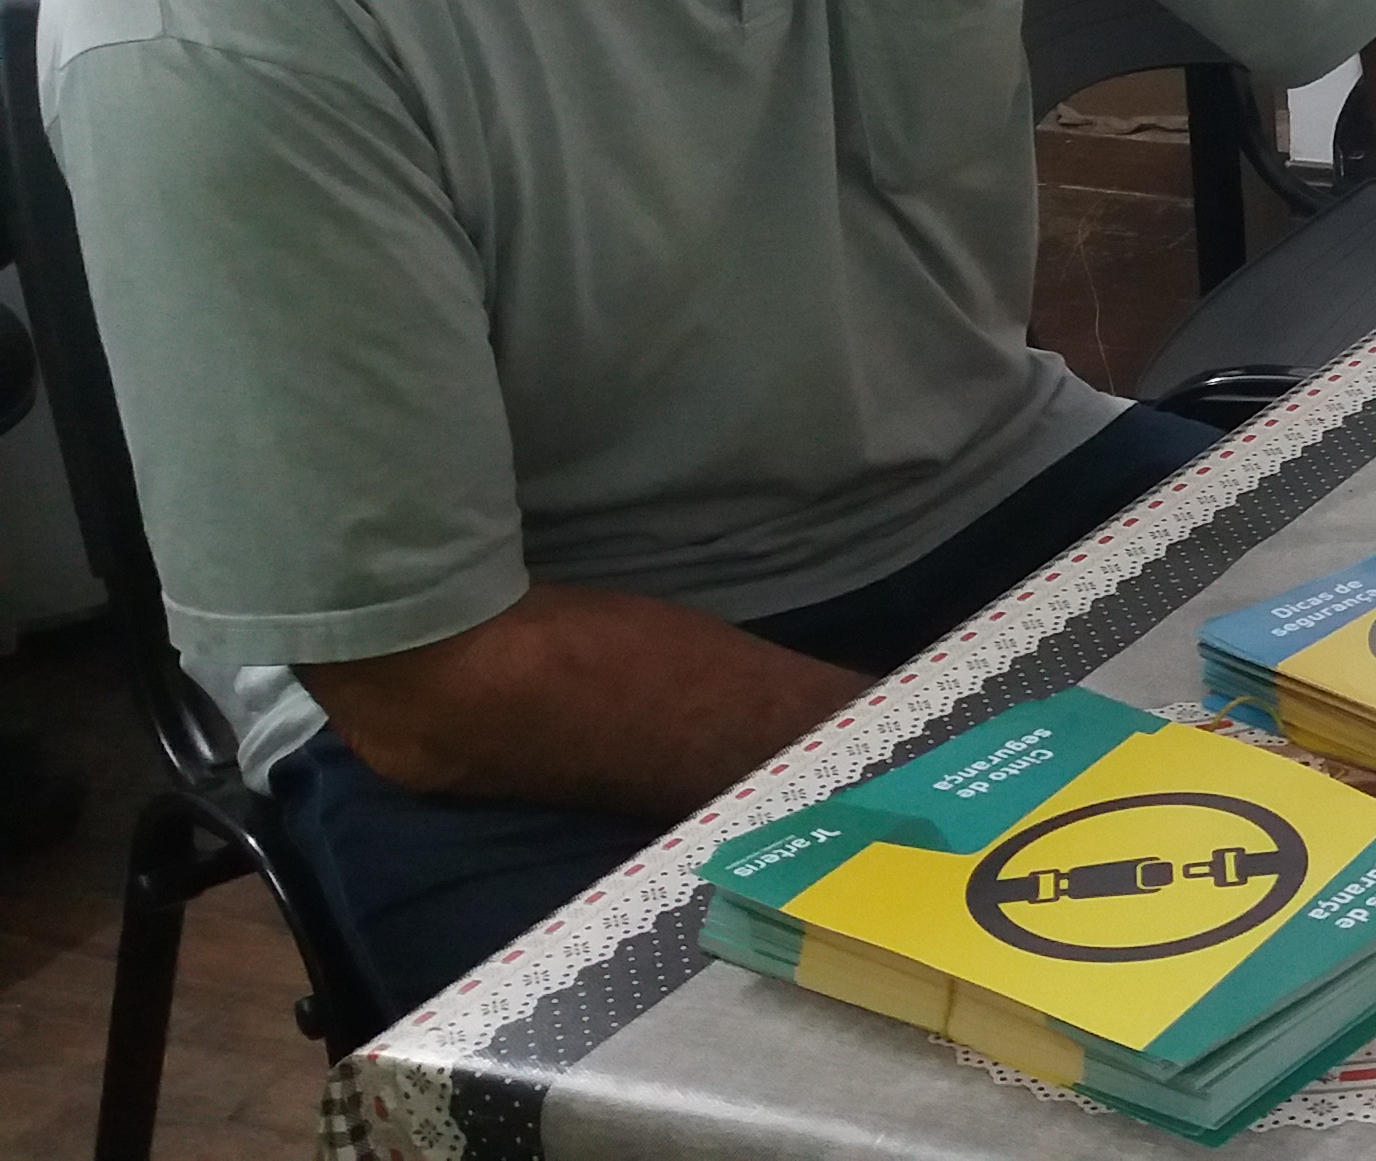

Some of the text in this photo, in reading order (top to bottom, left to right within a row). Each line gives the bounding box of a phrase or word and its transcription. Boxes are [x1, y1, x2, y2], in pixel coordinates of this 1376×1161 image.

[1270, 580, 1364, 619] Dicas de
[932, 728, 1053, 791] segurança
[955, 749, 1054, 798] Cinto de
[732, 838, 812, 877] arteris
[1334, 908, 1370, 929] de
